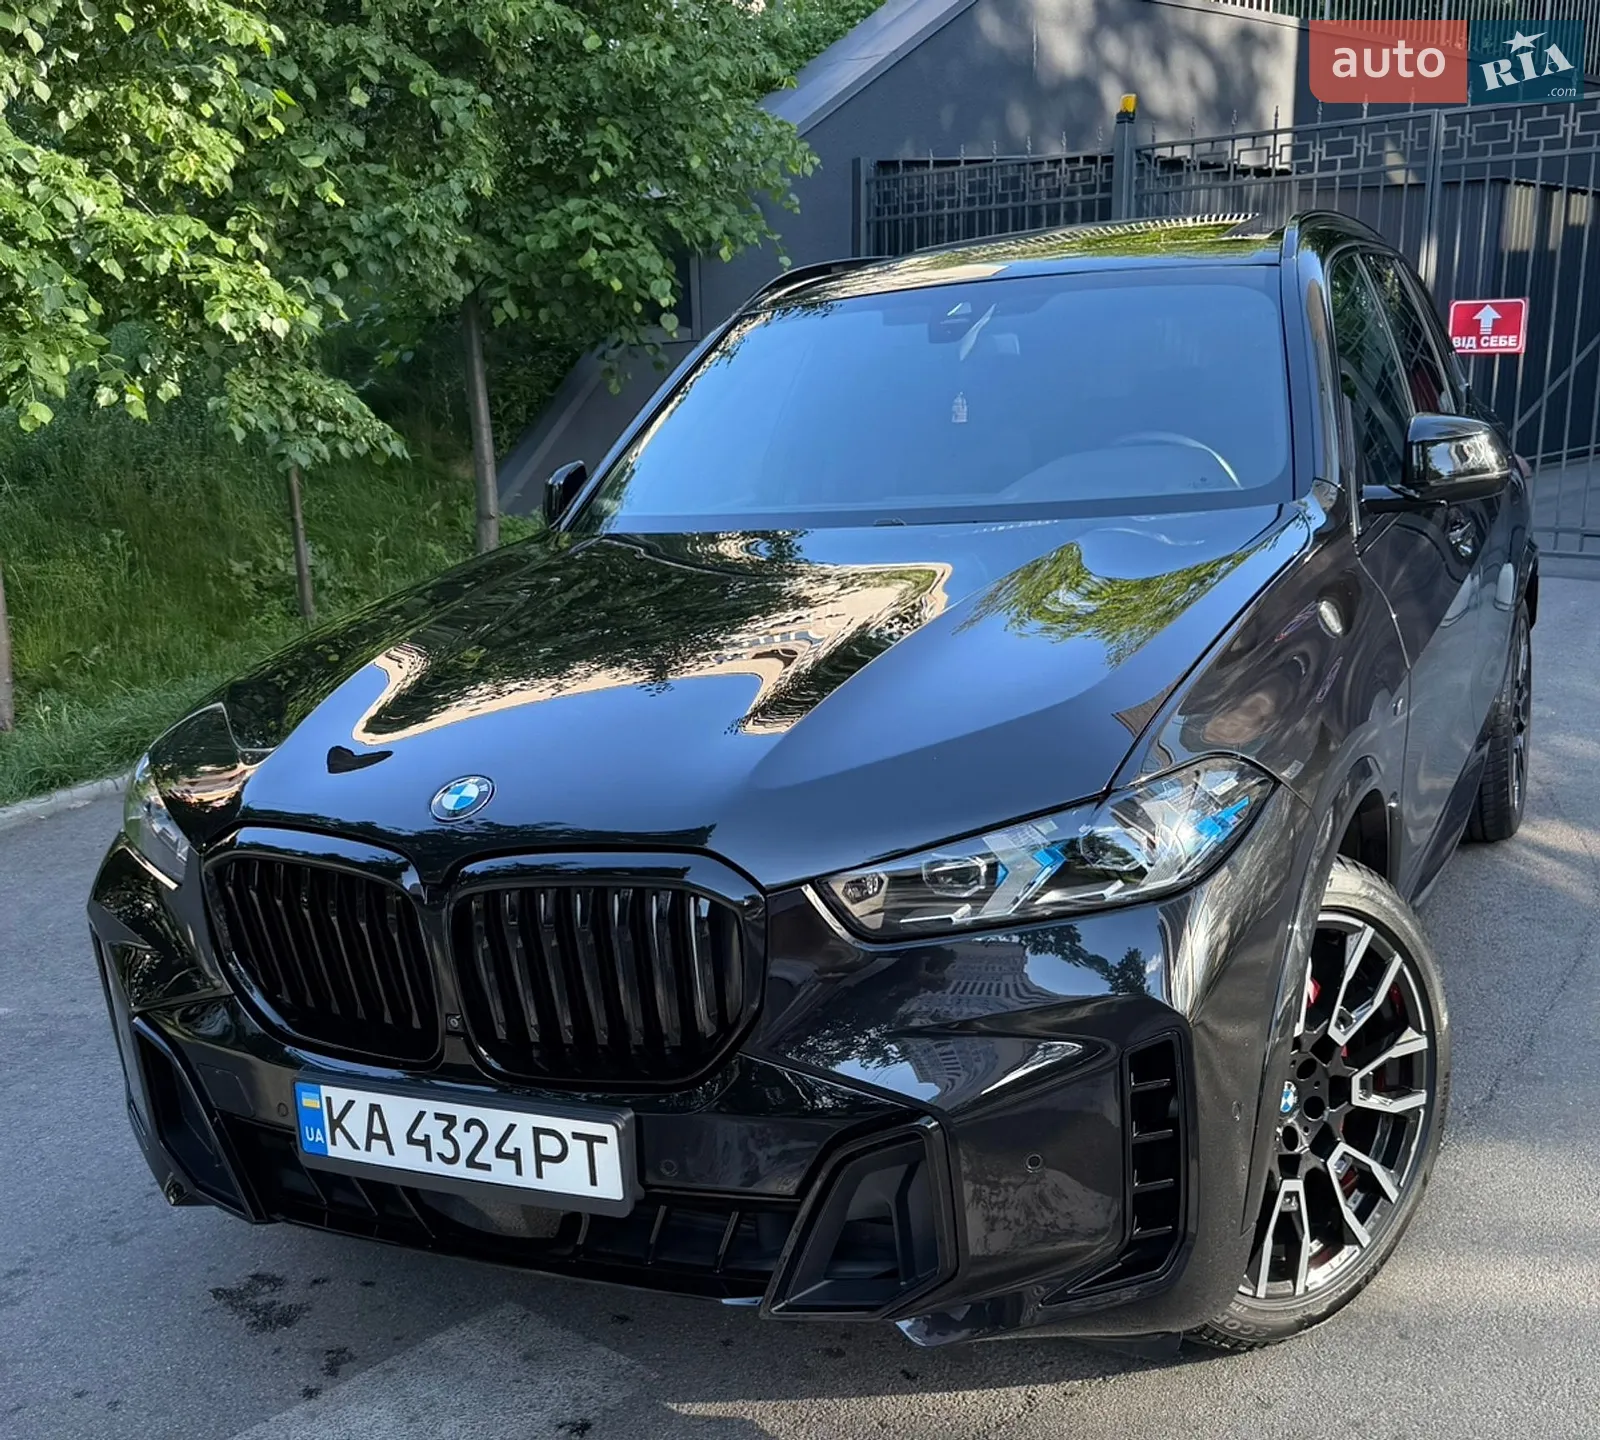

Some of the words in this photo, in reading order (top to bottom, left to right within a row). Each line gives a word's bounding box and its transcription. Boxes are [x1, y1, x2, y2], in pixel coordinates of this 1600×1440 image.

[1480, 335, 1518, 347] СЕБЕ
[305, 1126, 324, 1144] UA
[325, 1096, 395, 1156] KA
[406, 1110, 523, 1176] 4324
[532, 1126, 608, 1187] PT
